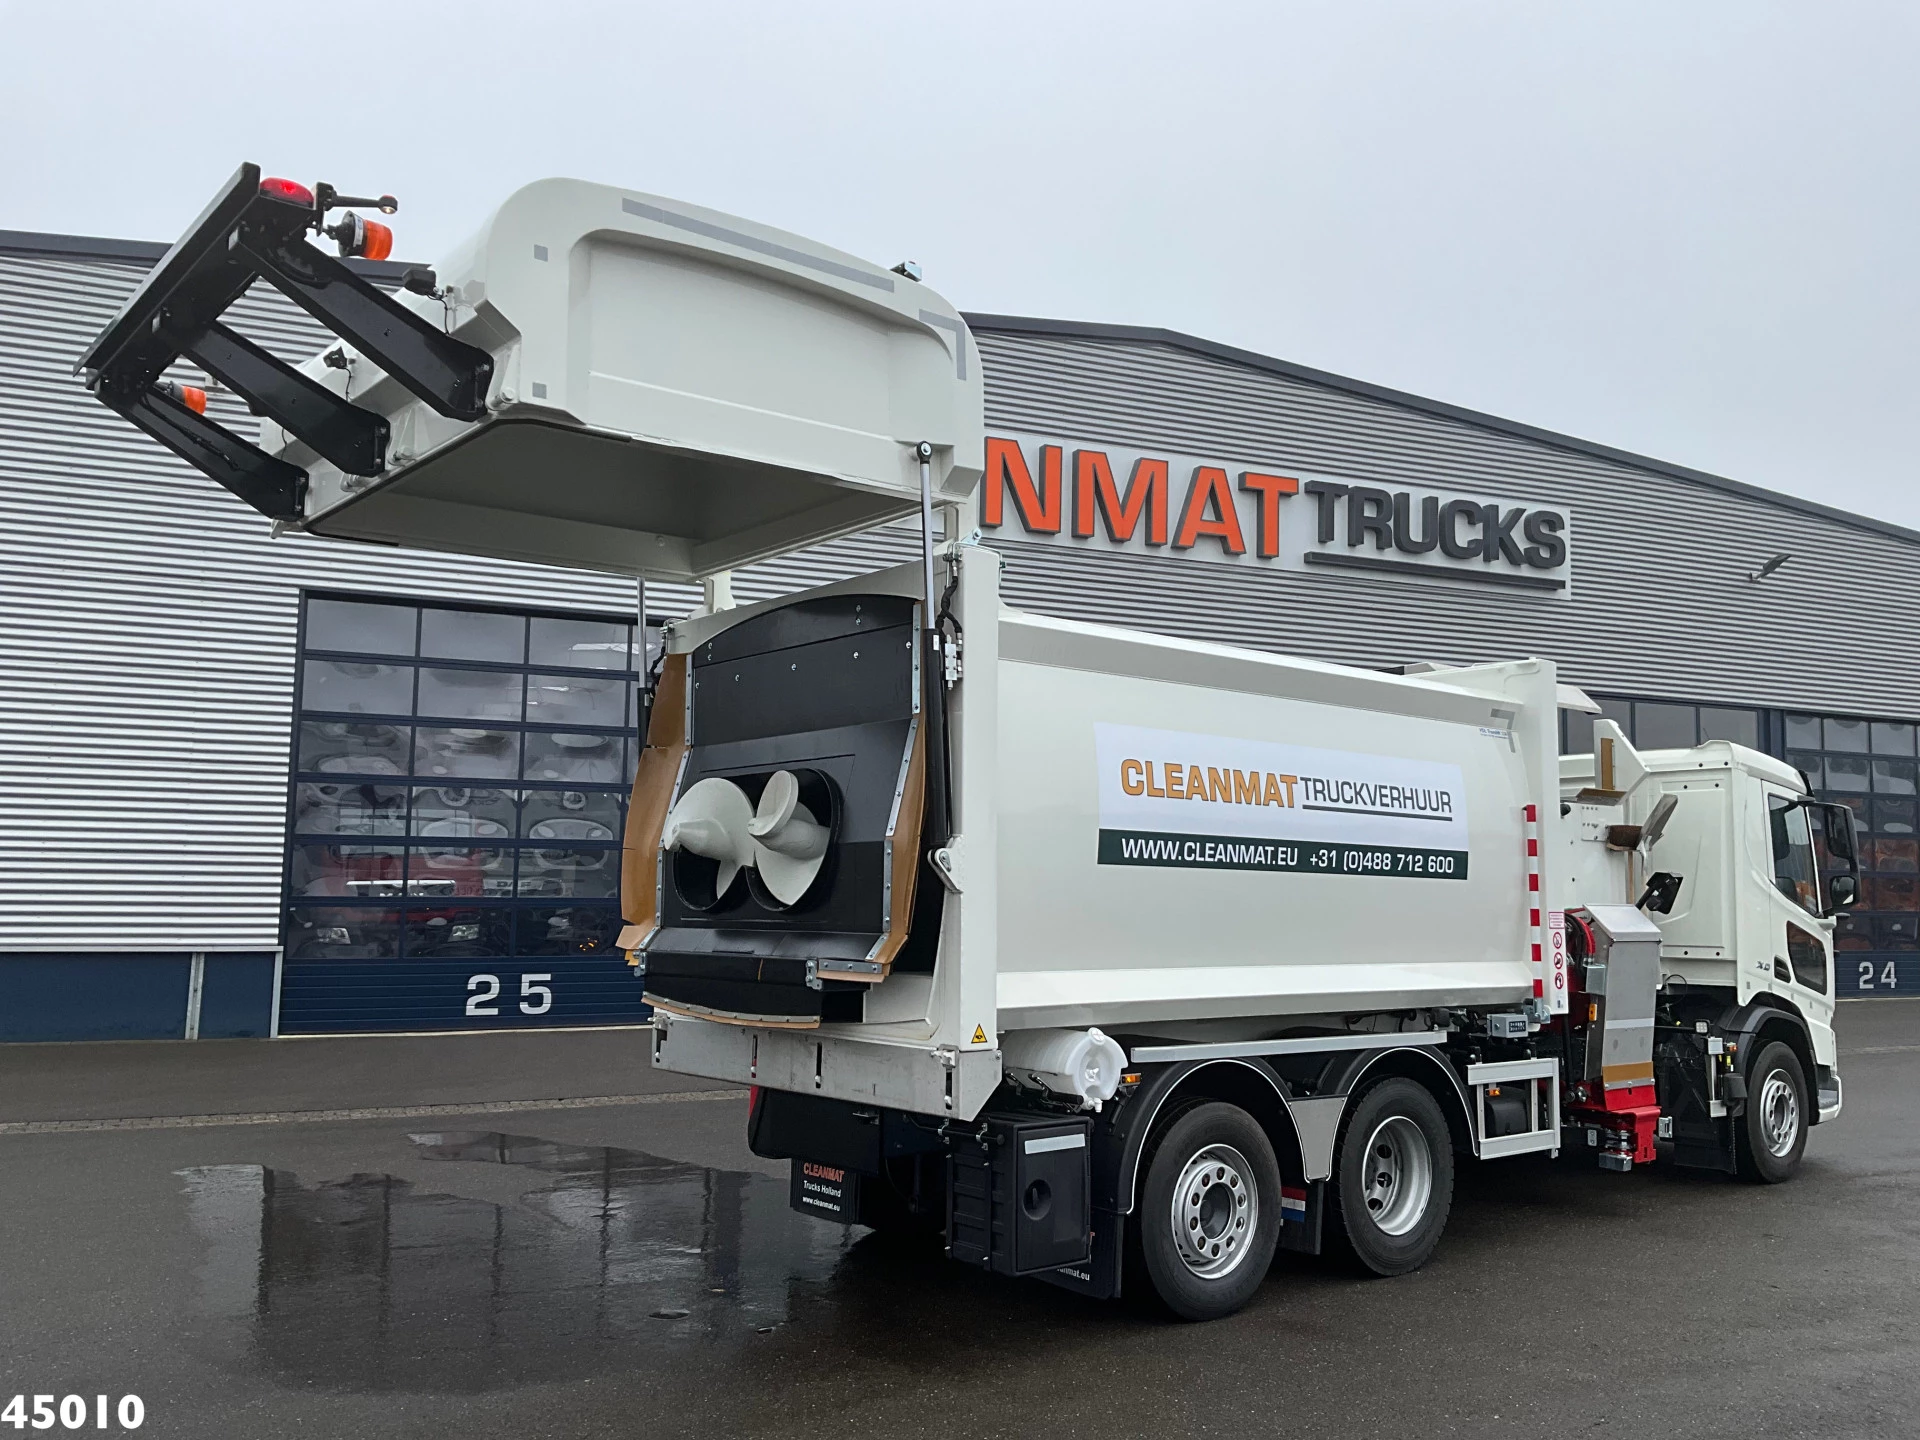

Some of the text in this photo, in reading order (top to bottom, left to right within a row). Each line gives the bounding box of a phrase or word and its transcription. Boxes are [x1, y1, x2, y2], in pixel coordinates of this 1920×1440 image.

[1304, 480, 1566, 569] TRUCKS
[1120, 758, 1453, 813] CLEANMAT TRUCKVERHUUR
[1121, 837, 1454, 874] WWW.CLEANMAT.EU +31 (0)488 712 600
[1858, 961, 1897, 989] 24
[465, 973, 552, 1016] 25
[803, 1162, 845, 1183] CLEANMAT
[802, 1196, 841, 1212] www.cleanmat.eu
[803, 1180, 841, 1198] Trucks Holland
